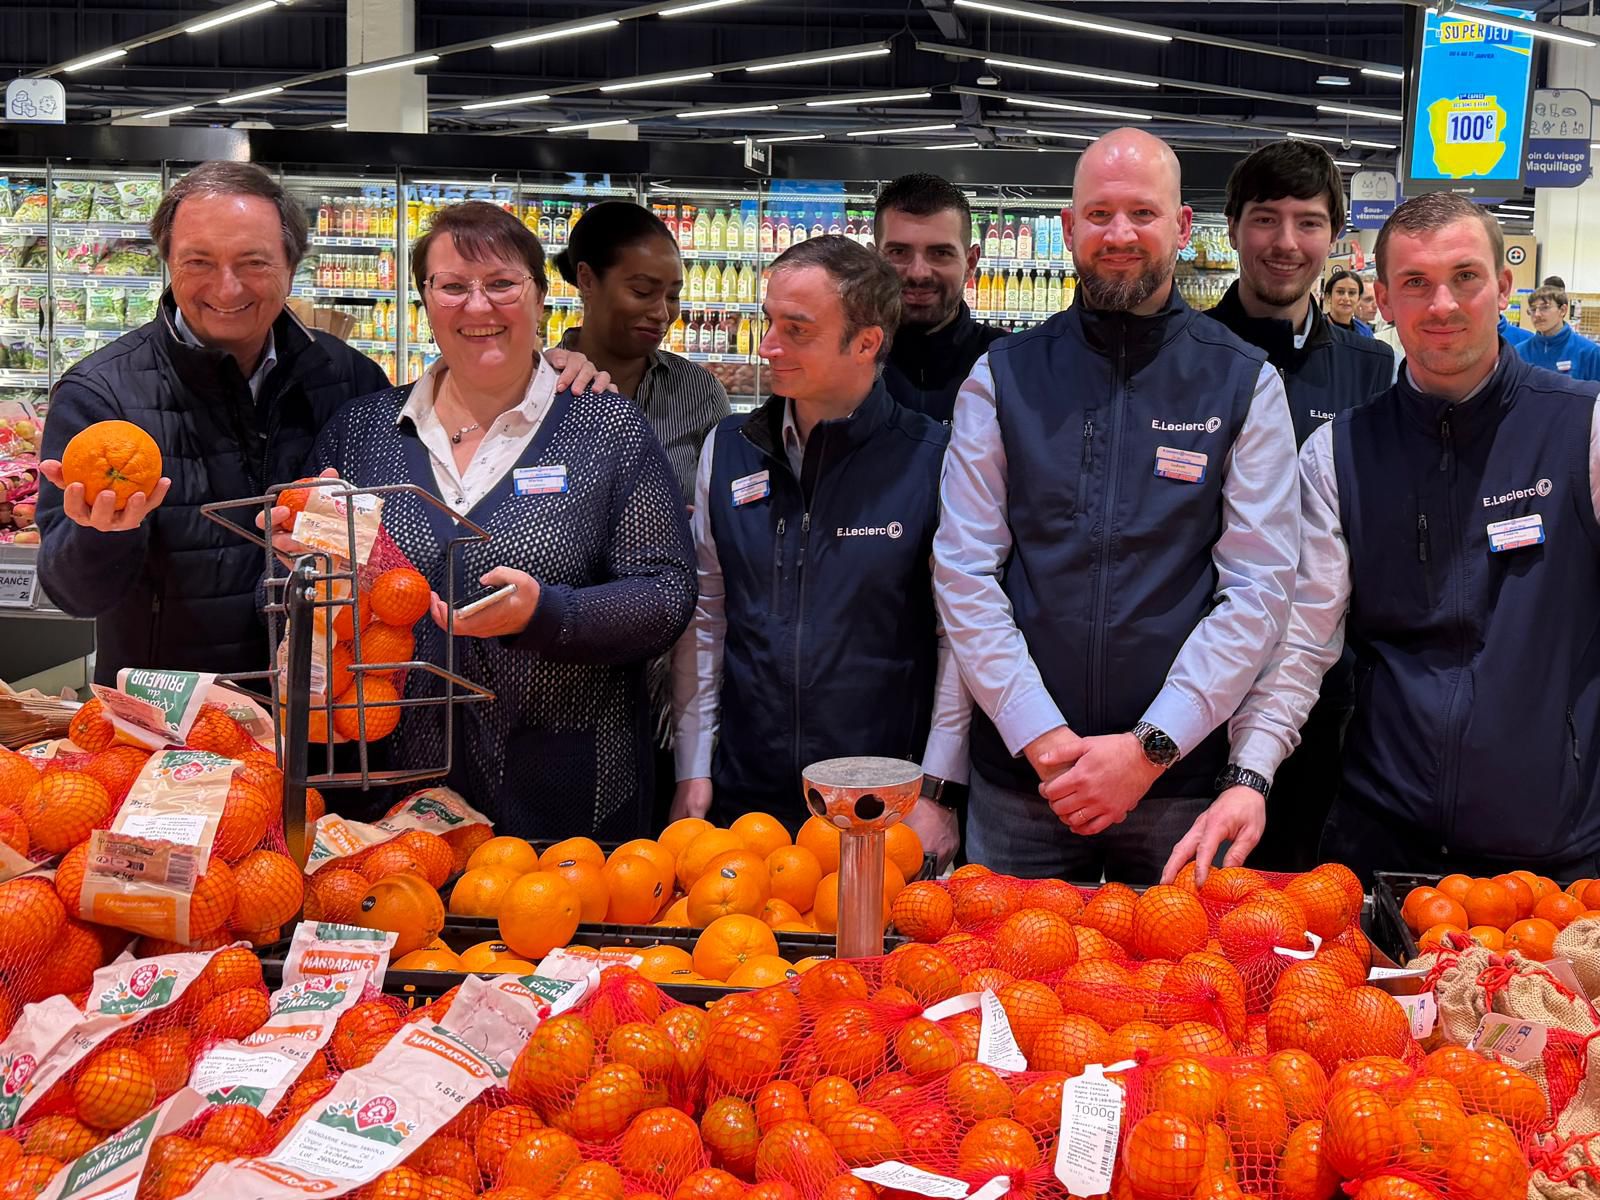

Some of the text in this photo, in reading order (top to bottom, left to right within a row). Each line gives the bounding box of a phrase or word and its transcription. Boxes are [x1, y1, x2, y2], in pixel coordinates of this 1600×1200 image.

[1445, 24, 1509, 40] SUPER JEU
[1451, 115, 1493, 141] 100€
[1528, 152, 1585, 161] oin du visage
[1526, 161, 1582, 173] Maquillage
[1152, 419, 1205, 432] E.Leclerc
[1483, 487, 1536, 507] E.Leclerc
[836, 527, 887, 537] E.Leclerc
[0, 577, 29, 586] RANCE
[130, 670, 187, 692] PRIMEUR
[303, 956, 375, 971] MANDARINES
[529, 981, 561, 999] PRIM
[410, 1034, 485, 1077] MANDARINES
[1075, 1104, 1116, 1121] 1000g
[72, 1138, 144, 1191] PRIMEUR
